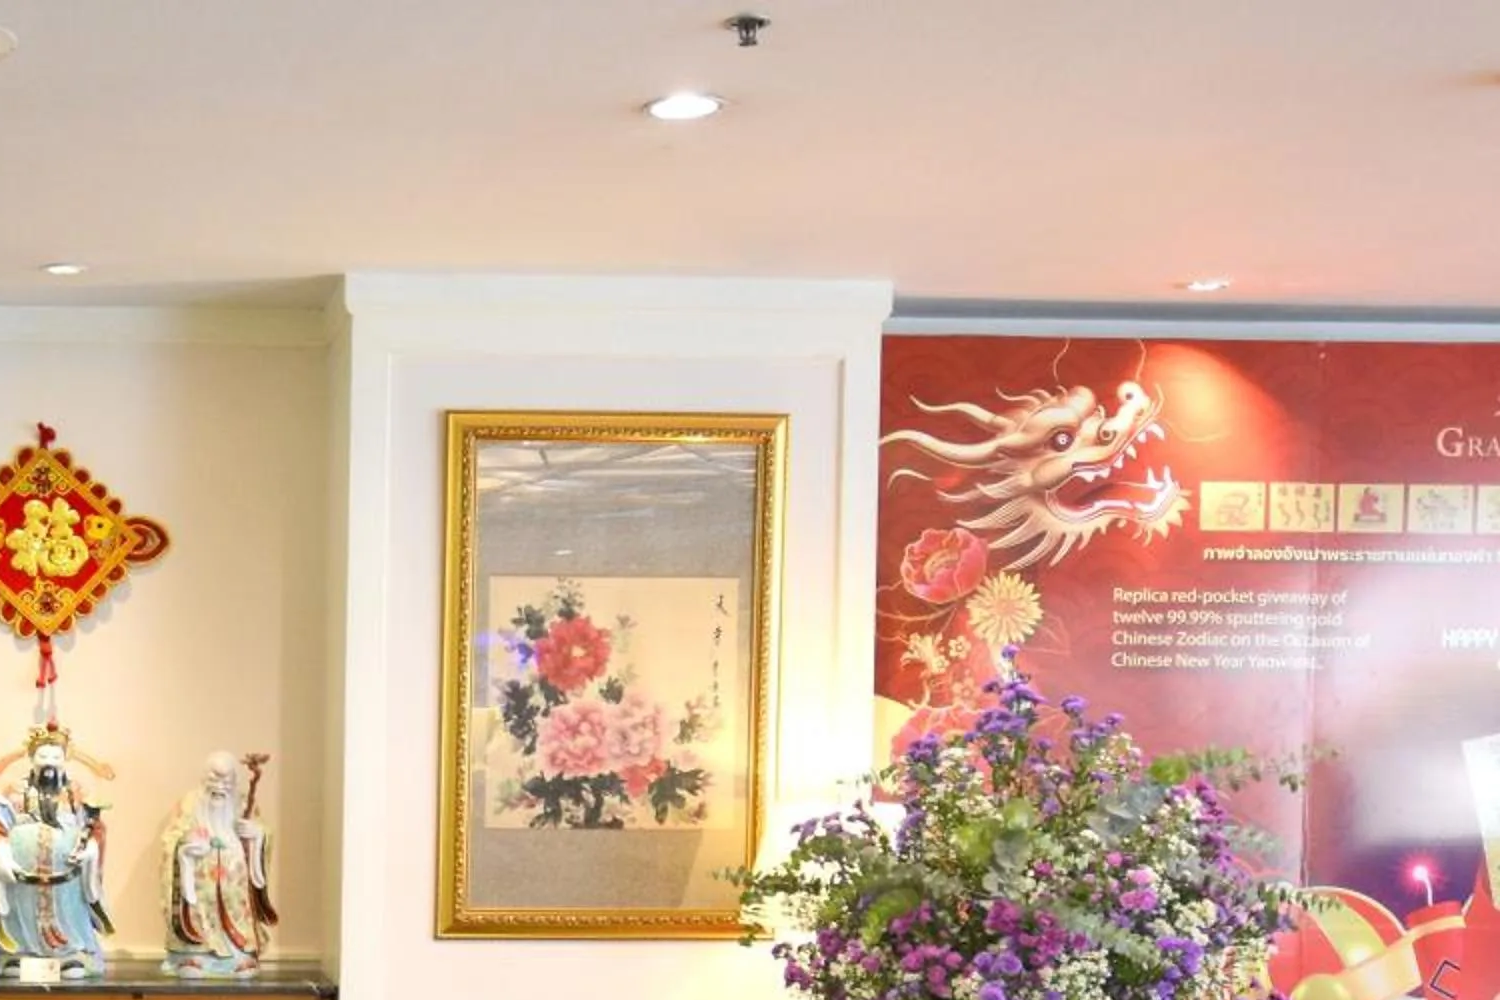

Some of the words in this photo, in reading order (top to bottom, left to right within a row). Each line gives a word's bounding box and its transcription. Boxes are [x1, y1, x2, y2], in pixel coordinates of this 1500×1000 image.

[5, 497, 89, 577] 福
[1113, 587, 1169, 604] Replica
[1171, 586, 1254, 605] red-pocket
[1257, 588, 1328, 608] giveaway
[1332, 589, 1348, 604] of
[1113, 608, 1164, 624] twelve
[1112, 630, 1173, 646] Chinese
[1175, 631, 1228, 646] Zodiac
[1230, 634, 1251, 647] on
[1354, 632, 1371, 648] of
[1442, 627, 1499, 650] HAPPY
[1111, 651, 1173, 667] Chinese
[1175, 652, 1210, 668] New
[1212, 654, 1243, 669] Year
